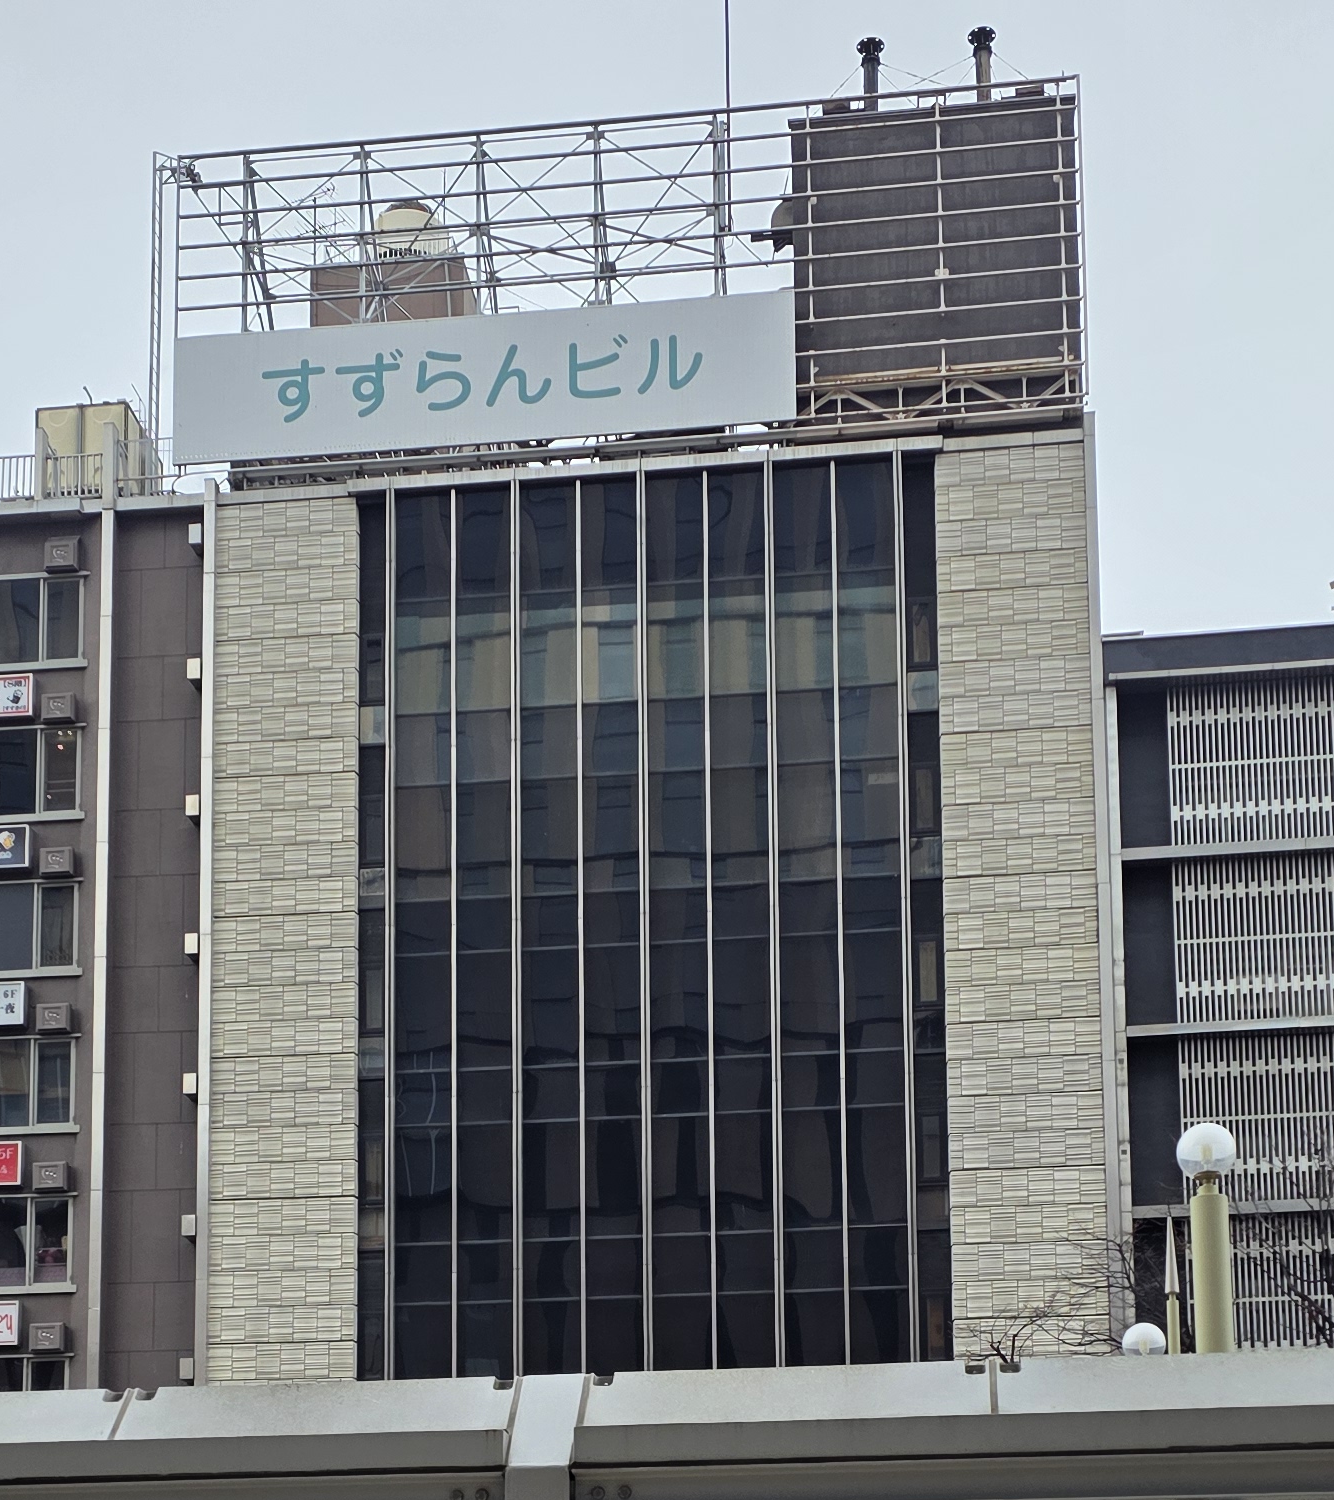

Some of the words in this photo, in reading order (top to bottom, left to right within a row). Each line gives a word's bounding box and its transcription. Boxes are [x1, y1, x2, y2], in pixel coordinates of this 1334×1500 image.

[261, 333, 703, 423] すずらんビル
[3, 989, 17, 999] 6F
